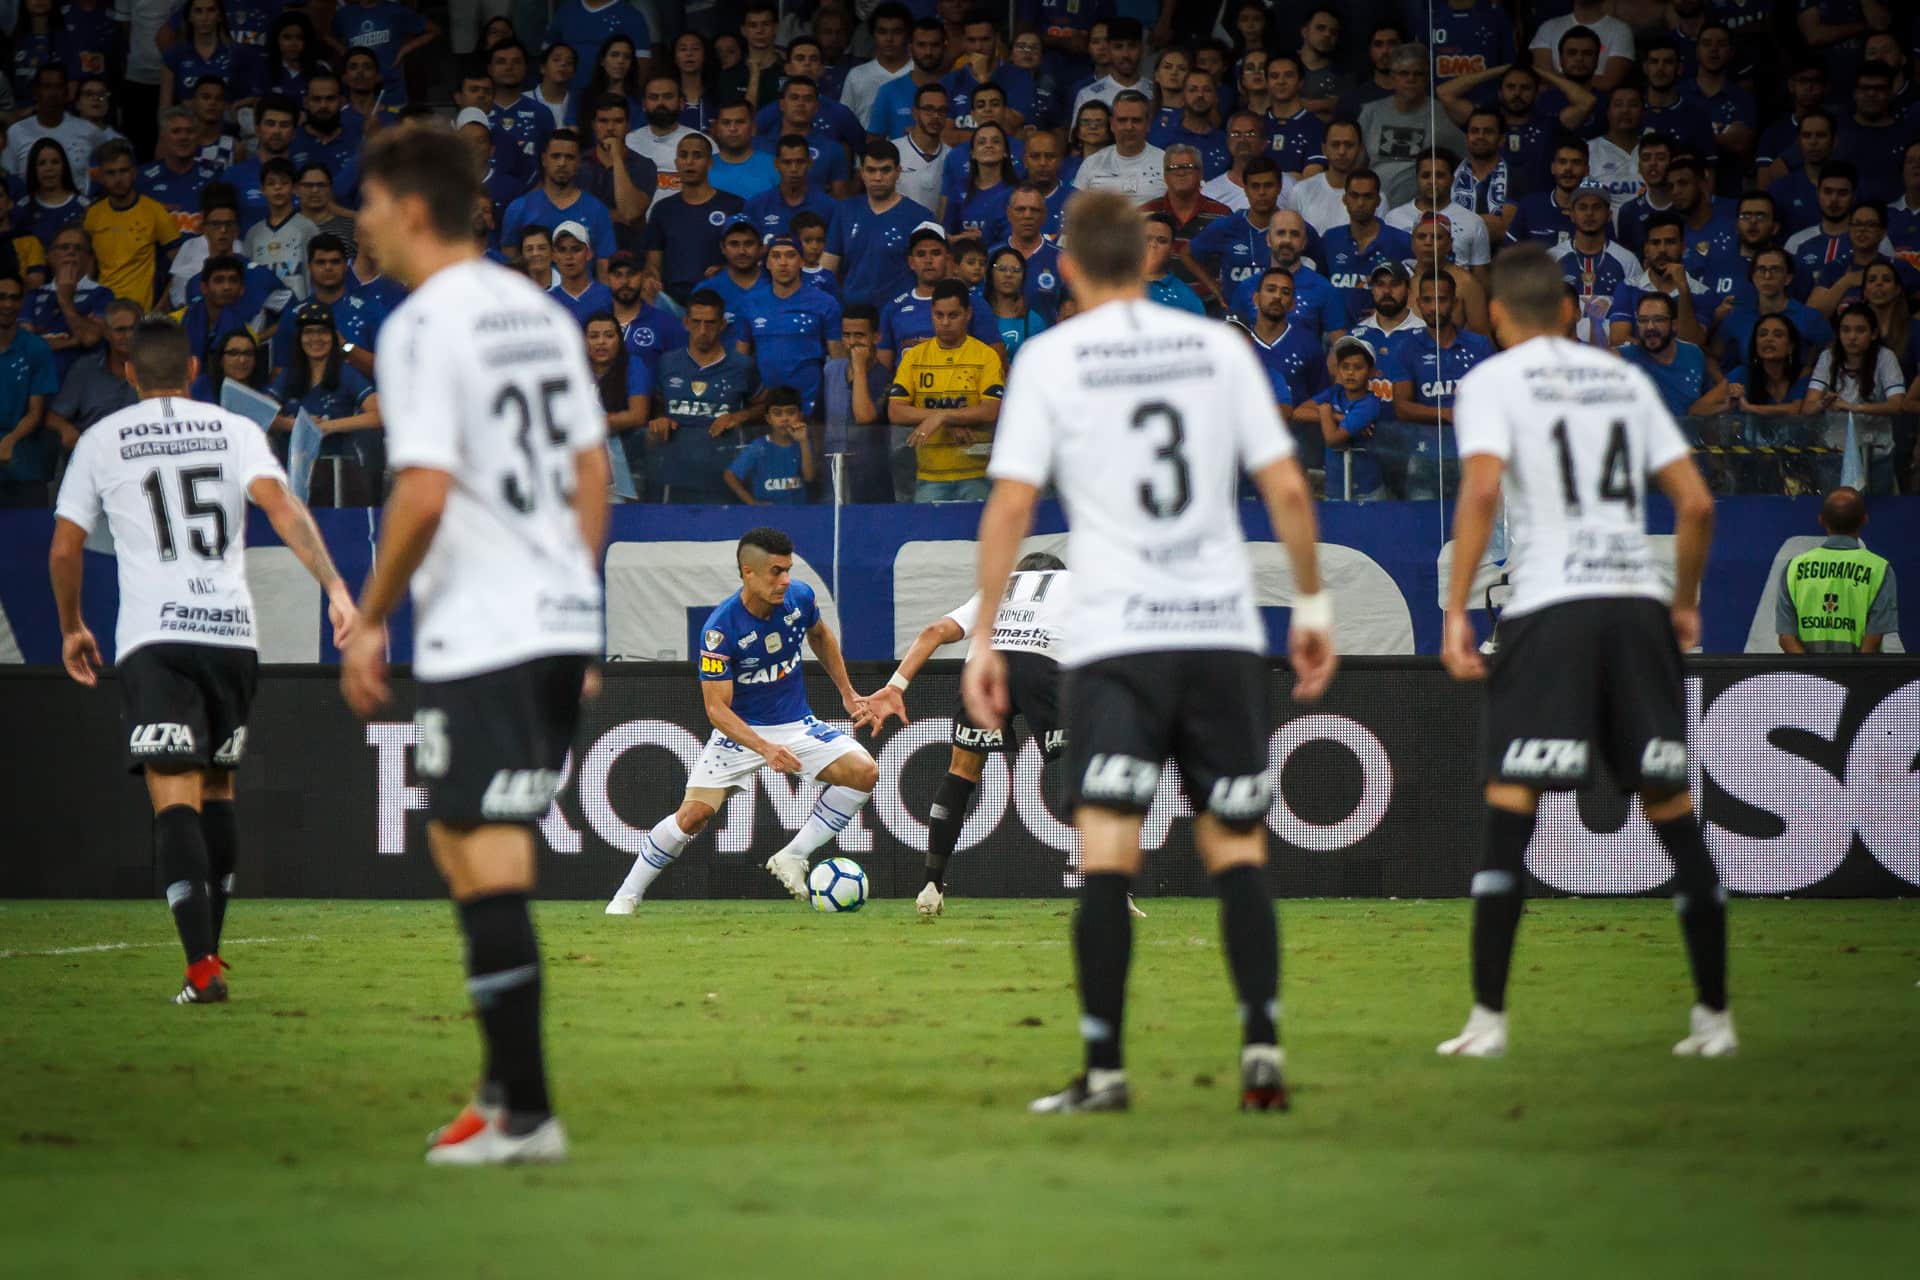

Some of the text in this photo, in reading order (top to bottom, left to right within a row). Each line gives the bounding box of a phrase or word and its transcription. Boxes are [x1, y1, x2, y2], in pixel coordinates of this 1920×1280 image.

[1436, 54, 1486, 76] BMG
[1715, 277, 1733, 293] 10
[919, 372, 934, 389] 10
[119, 420, 222, 441] POSITIVO
[121, 438, 227, 459] SMARTPHONES
[492, 378, 572, 512] 35
[1130, 401, 1191, 518] 3
[1551, 417, 1637, 520] 14
[140, 463, 228, 562] 15
[1797, 561, 1872, 588] SEGURANÇA
[160, 601, 250, 625] Famastil
[999, 608, 1035, 622] ROMERO
[1801, 616, 1857, 632] ESQUADRA
[991, 627, 1051, 642] amastil
[737, 650, 802, 684] CAIXA
[129, 723, 194, 746] ULTRA
